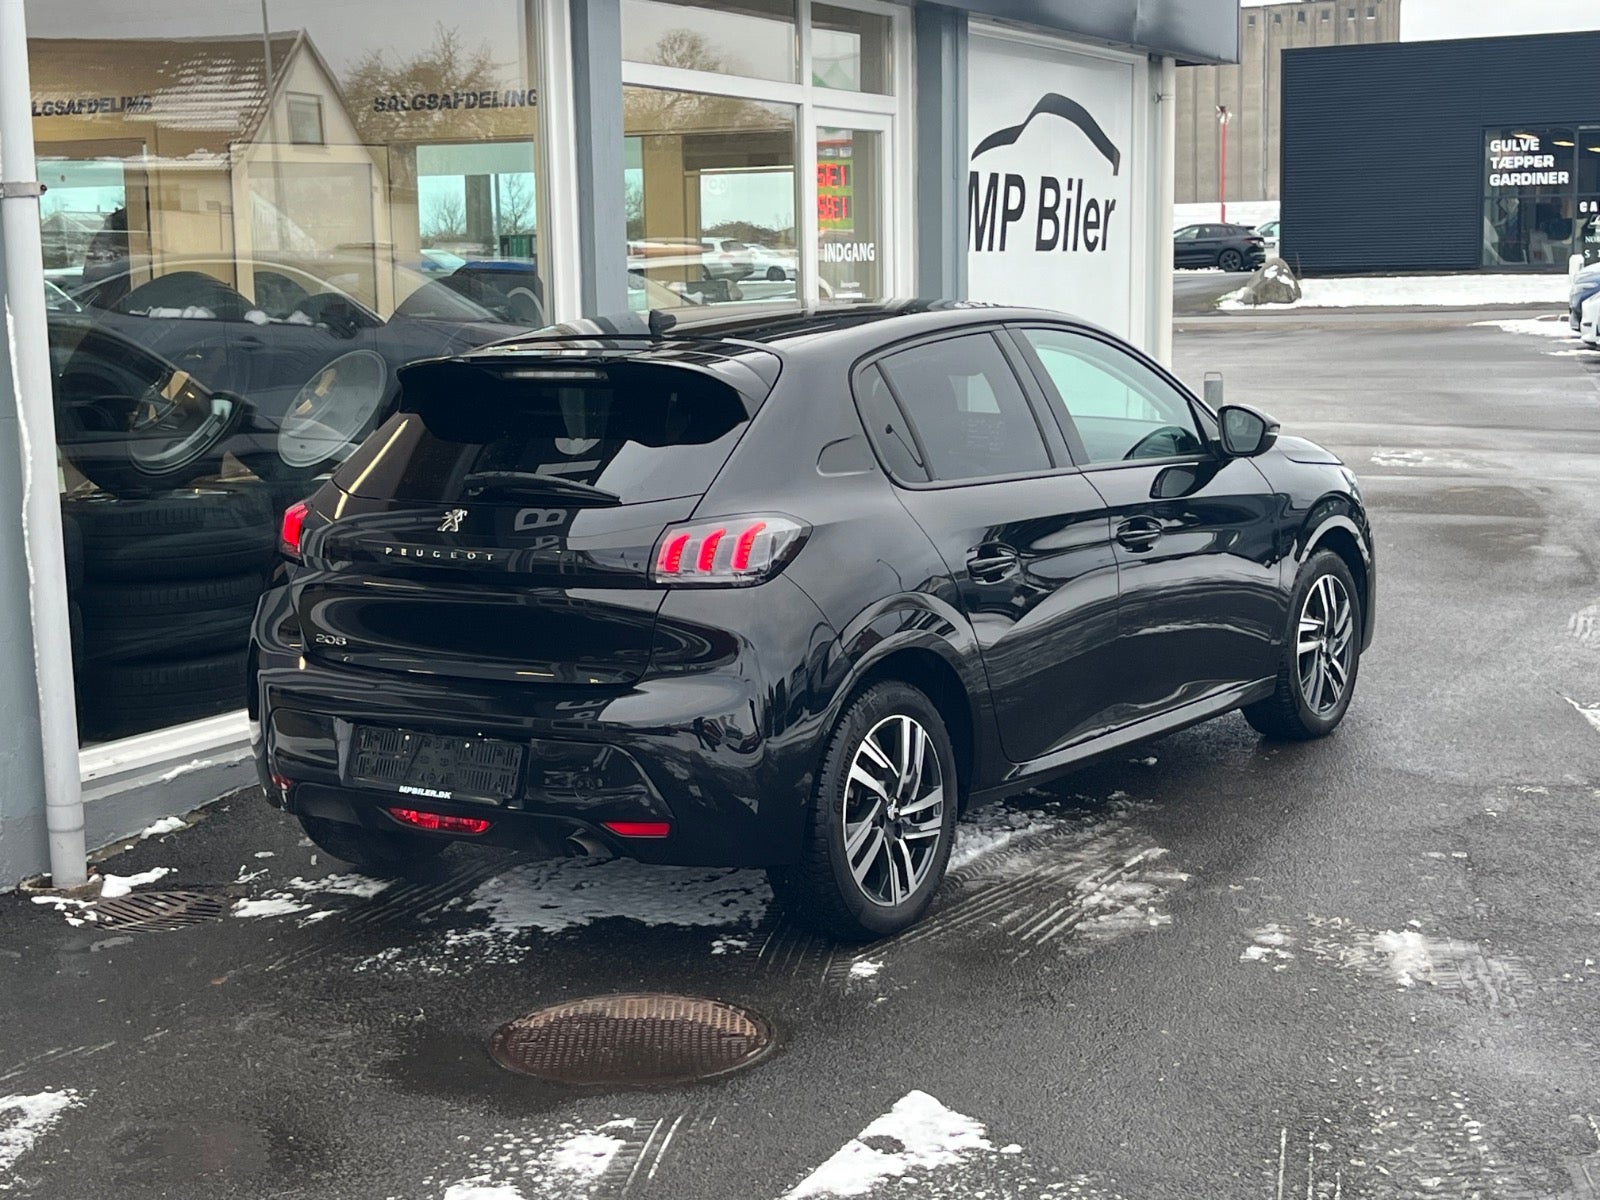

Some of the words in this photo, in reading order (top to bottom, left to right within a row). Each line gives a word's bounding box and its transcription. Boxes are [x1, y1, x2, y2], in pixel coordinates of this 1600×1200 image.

[1490, 139, 1540, 152] GULVE
[1490, 155, 1555, 169] TÆPPER
[1489, 171, 1569, 186] GARDINER
[968, 171, 1026, 252] MP
[1035, 176, 1117, 252] Biler
[824, 243, 875, 263] INDGANG
[385, 547, 494, 561] PEUGEOT
[315, 633, 347, 646] 208
